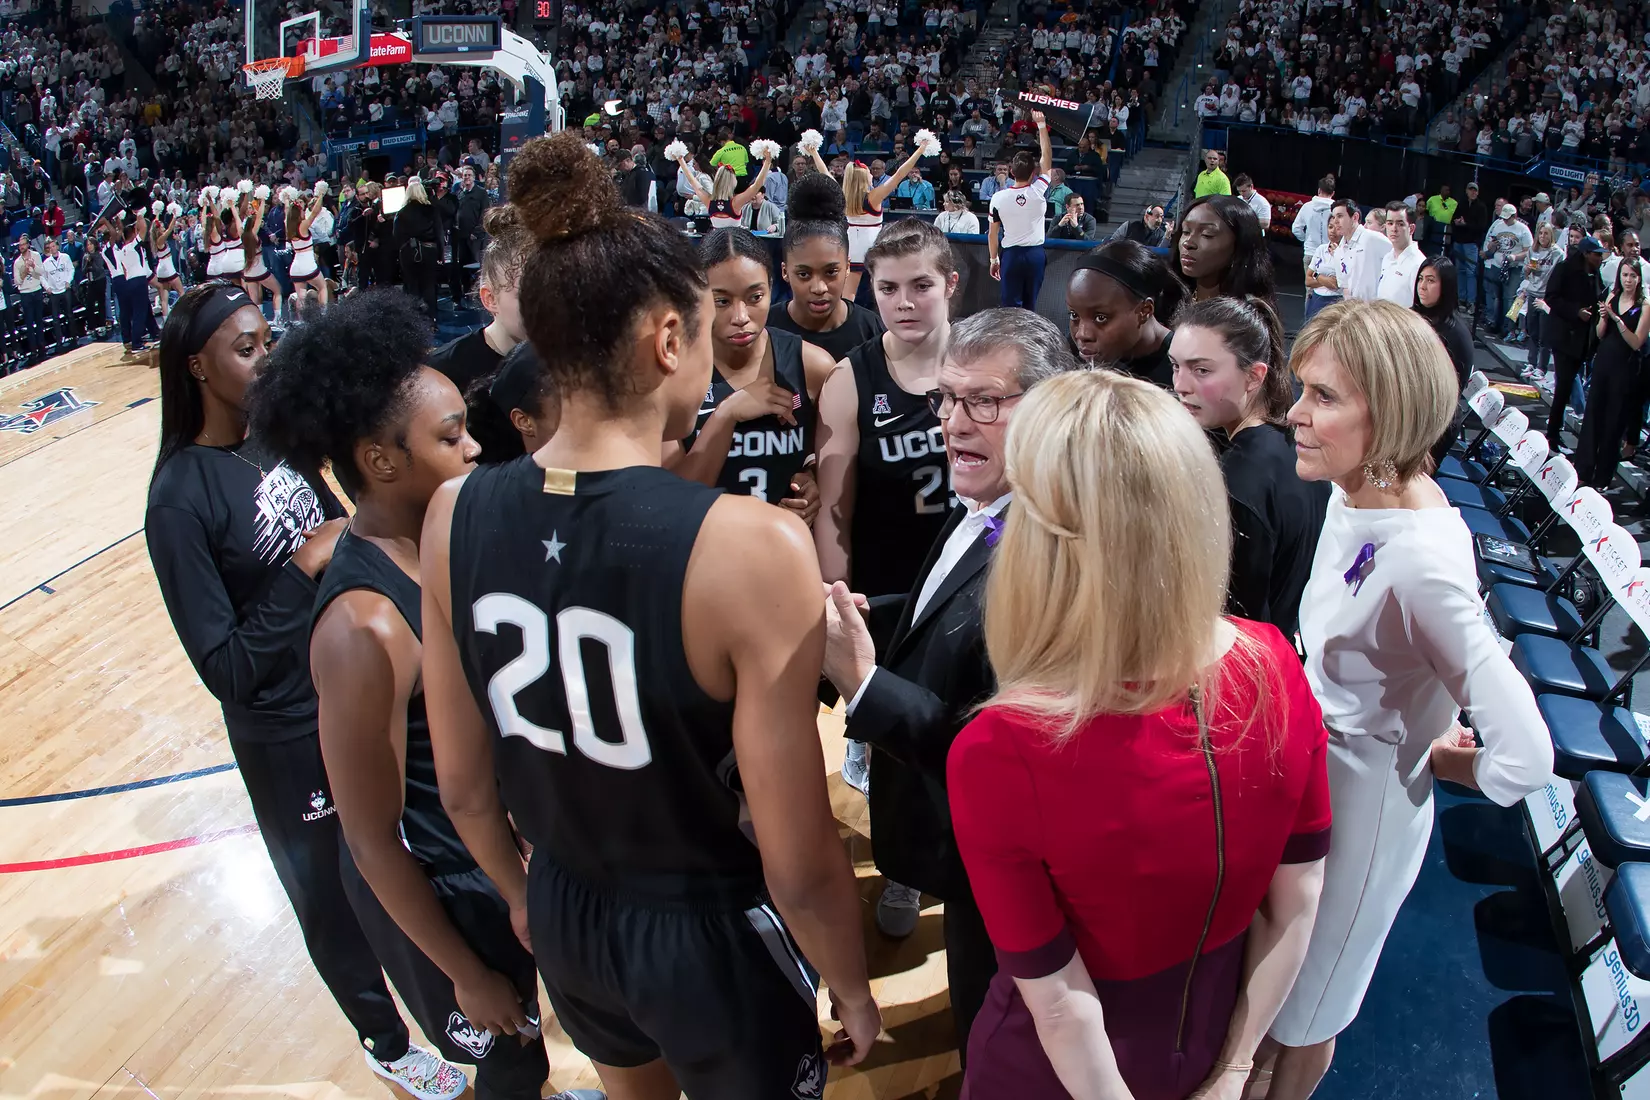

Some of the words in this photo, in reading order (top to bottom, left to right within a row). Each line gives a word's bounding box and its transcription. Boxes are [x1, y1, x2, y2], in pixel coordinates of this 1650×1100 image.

[537, 1, 550, 18] 30
[428, 25, 487, 44] UCONN
[1018, 91, 1080, 111] HUSKIES
[1550, 167, 1564, 176] BUD
[1564, 169, 1584, 180] LIGHT
[727, 426, 804, 459] CONN
[738, 466, 768, 503] 3
[1605, 543, 1629, 572] TICKET
[472, 591, 652, 770] 20
[302, 804, 337, 822] UCONN
[1603, 950, 1640, 1033] genius3D
